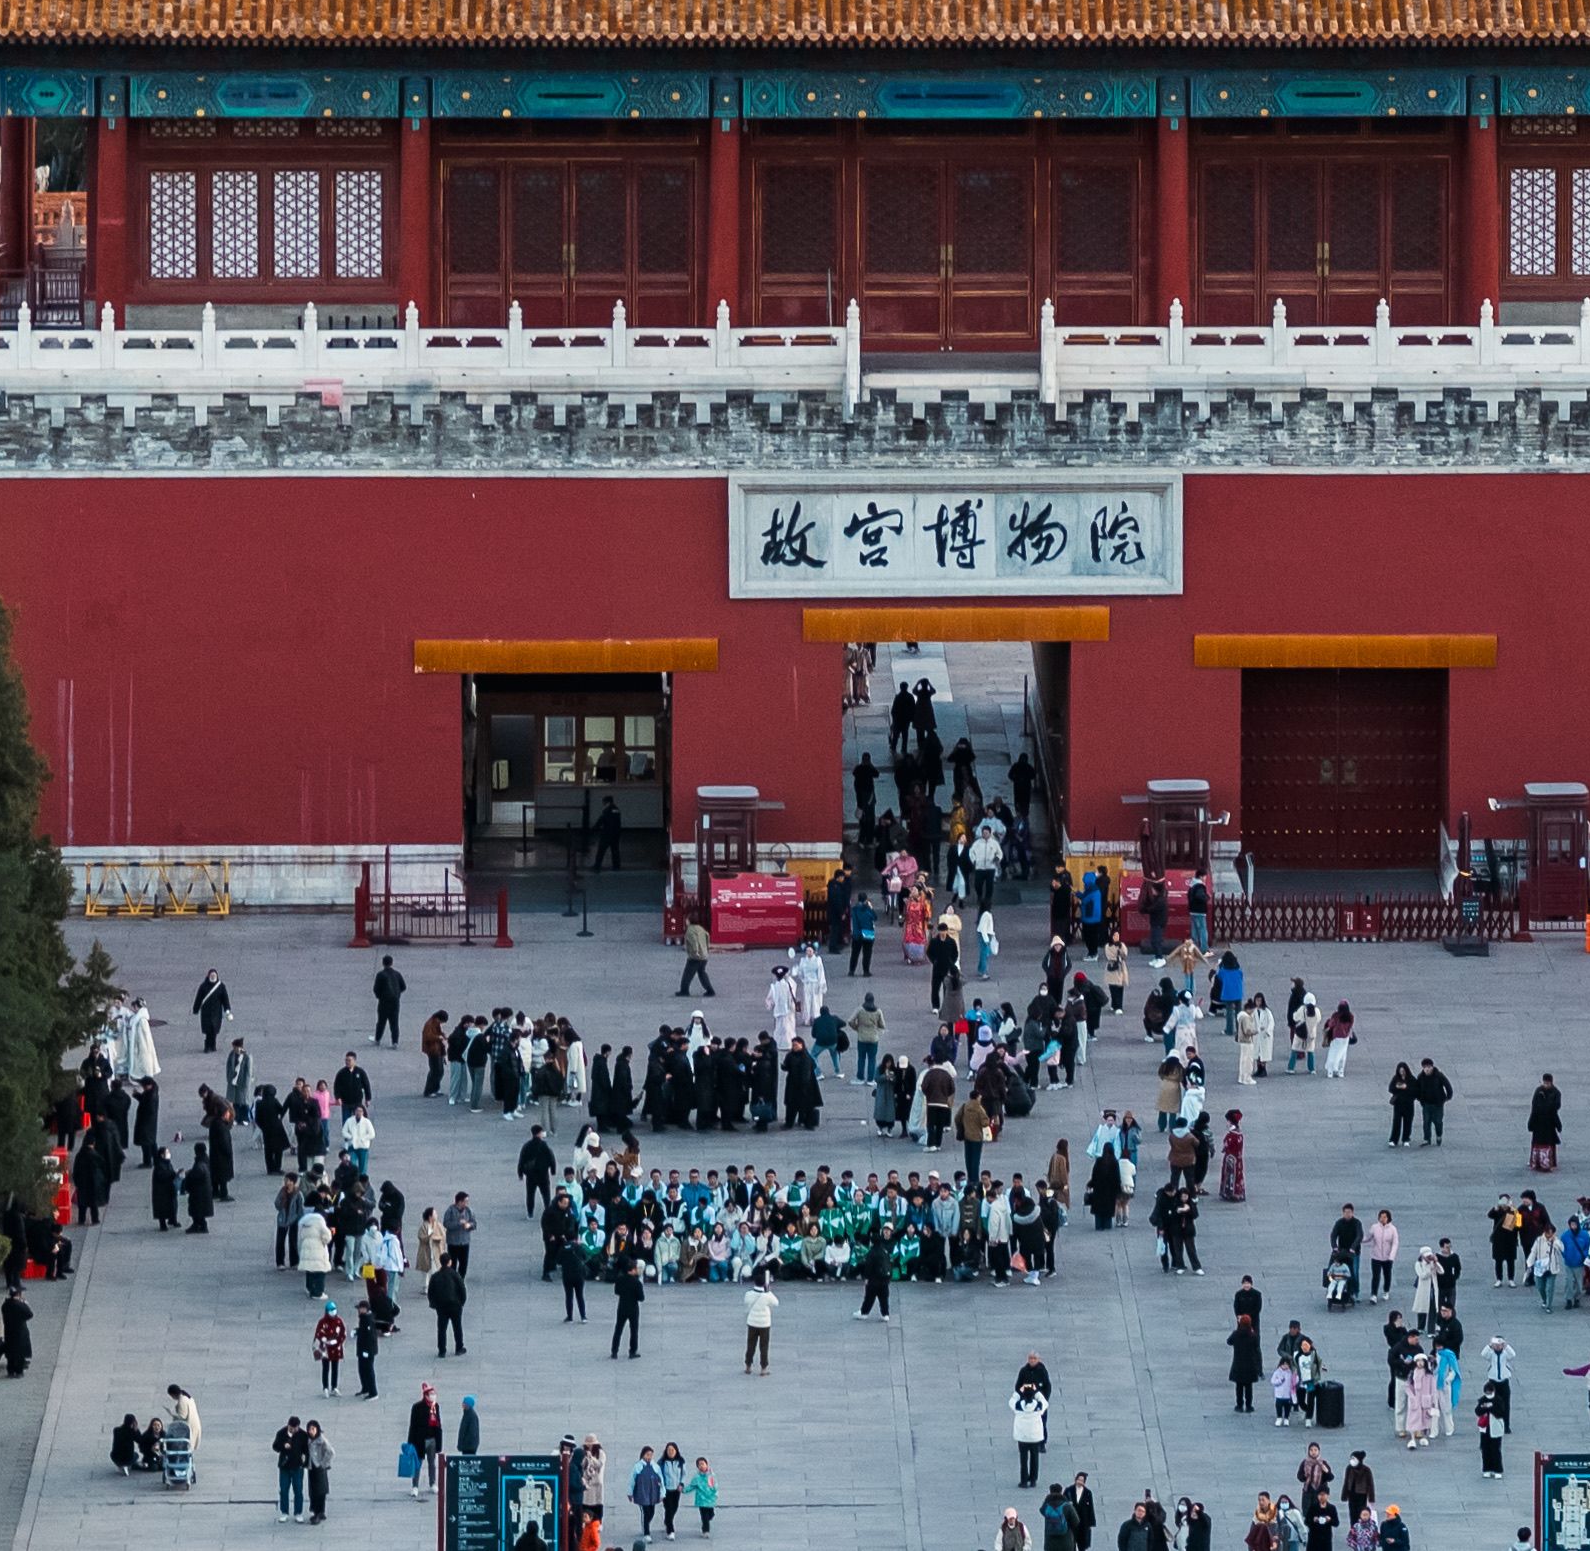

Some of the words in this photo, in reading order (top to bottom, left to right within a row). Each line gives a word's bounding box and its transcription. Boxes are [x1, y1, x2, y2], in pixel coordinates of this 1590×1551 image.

[760, 499, 1144, 568] 故宫博物院
